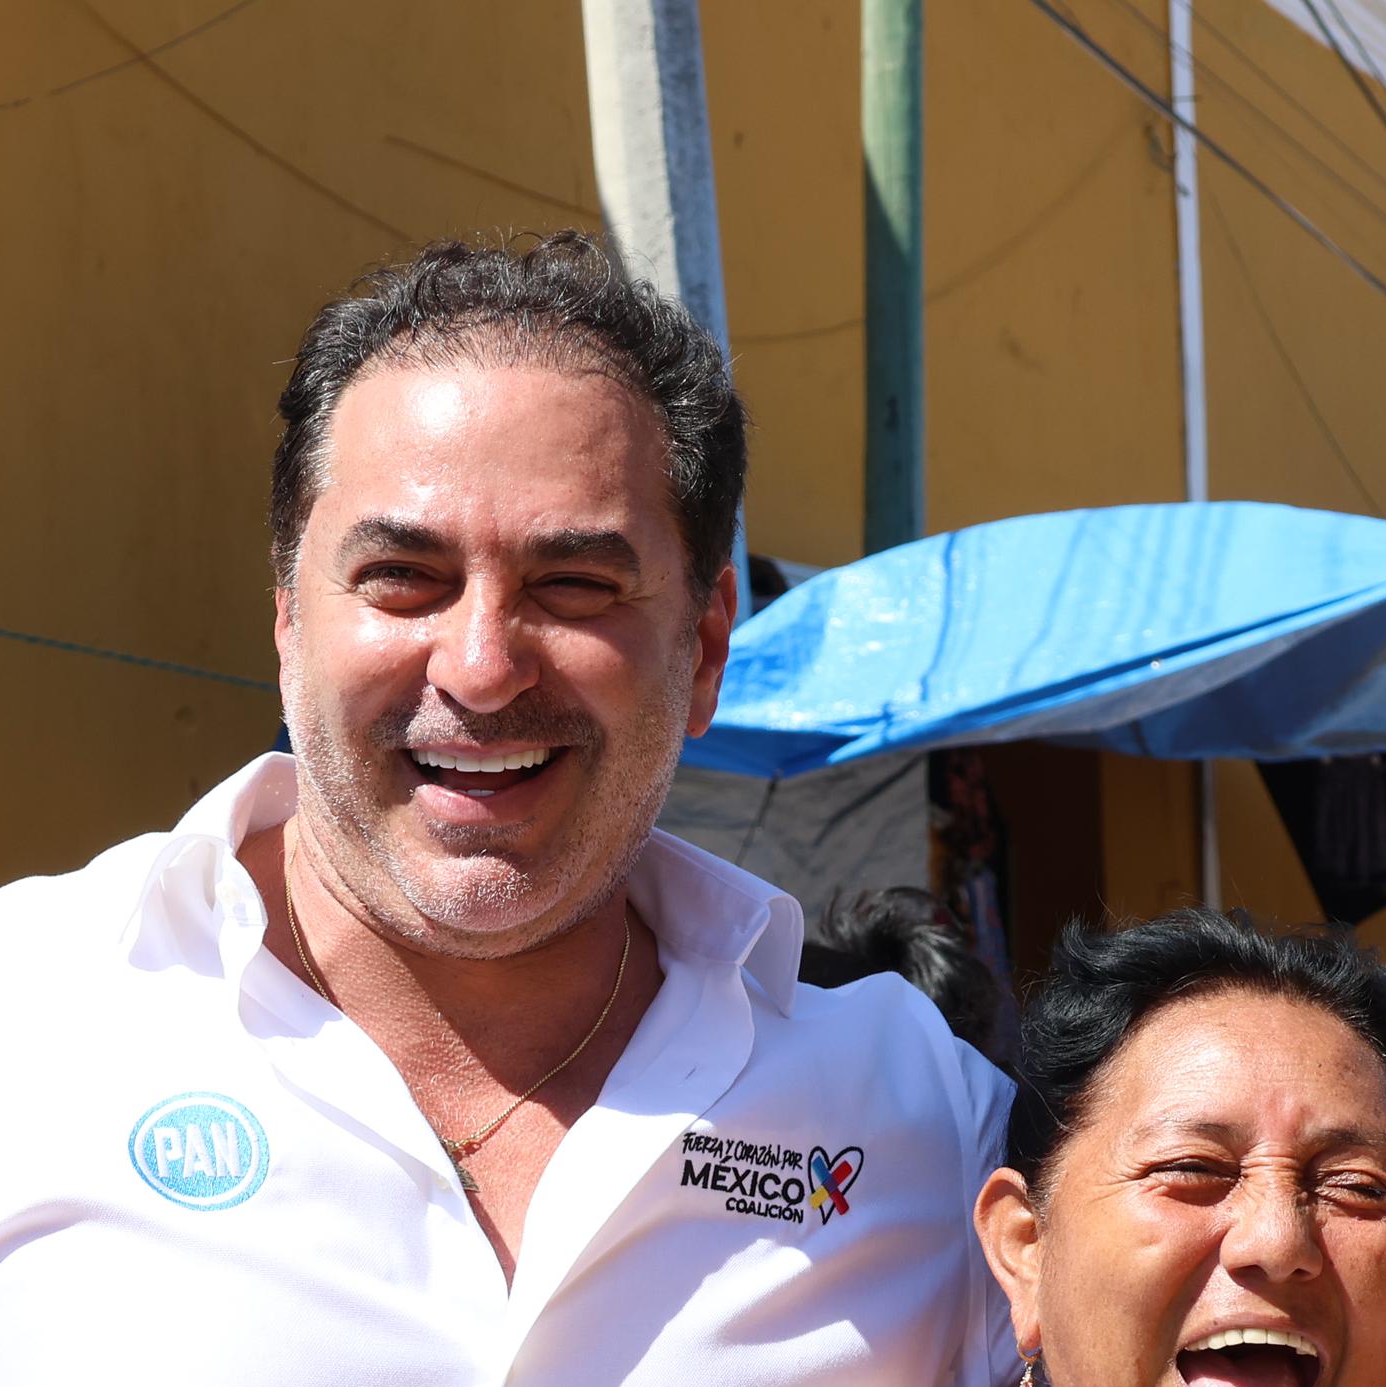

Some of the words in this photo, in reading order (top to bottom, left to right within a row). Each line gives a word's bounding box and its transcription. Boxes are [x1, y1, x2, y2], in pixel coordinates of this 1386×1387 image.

[153, 1120, 241, 1178] PAN
[682, 1132, 724, 1158] FUERZA
[725, 1139, 734, 1155] Y
[734, 1140, 781, 1168] CORAZÓN
[782, 1151, 803, 1170] POR
[681, 1156, 805, 1205] MÉXICO
[725, 1197, 804, 1224] COALICIÓN
